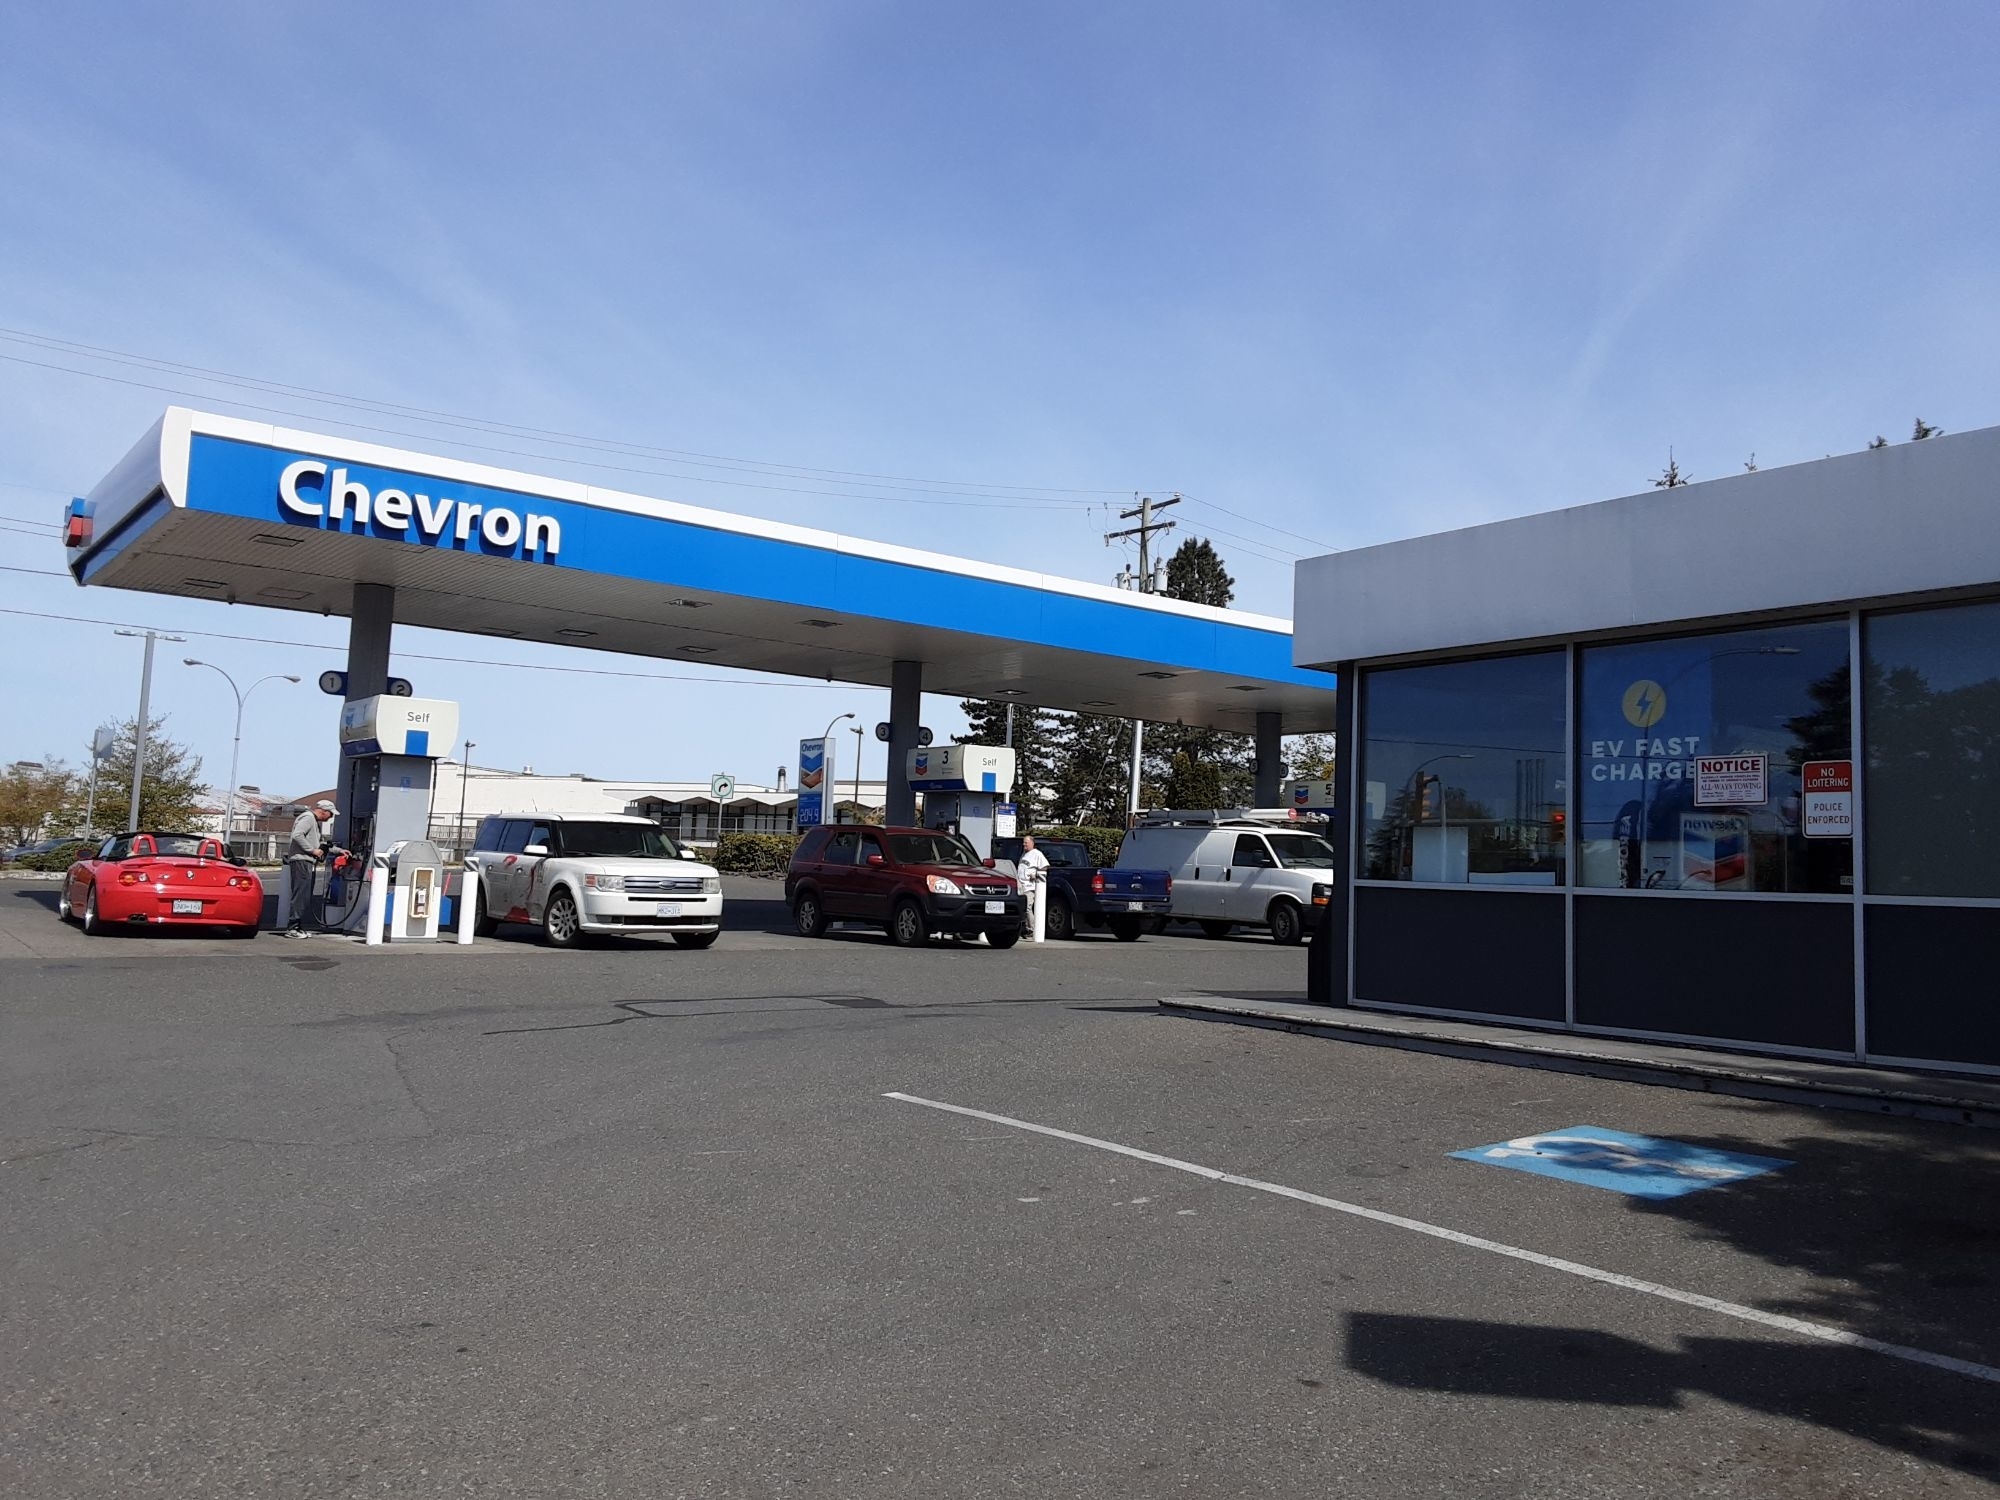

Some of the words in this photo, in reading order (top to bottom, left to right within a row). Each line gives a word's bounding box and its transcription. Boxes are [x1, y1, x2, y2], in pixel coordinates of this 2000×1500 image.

[280, 460, 560, 554] Chevron
[329, 677, 335, 688] 1
[396, 684, 405, 695] 2
[407, 711, 430, 723] Self
[880, 727, 886, 737] 3
[1592, 740, 1624, 758] EV
[1635, 737, 1699, 757] FAST
[942, 750, 949, 765] 3
[982, 757, 997, 767] Self
[1591, 761, 1695, 781] CHARGE
[1701, 759, 1760, 773] NOTICE
[1820, 767, 1835, 777] NO
[1807, 778, 1849, 788] LOITERING
[1814, 802, 1843, 812] POLICE
[1807, 815, 1850, 825] ENFORCED
